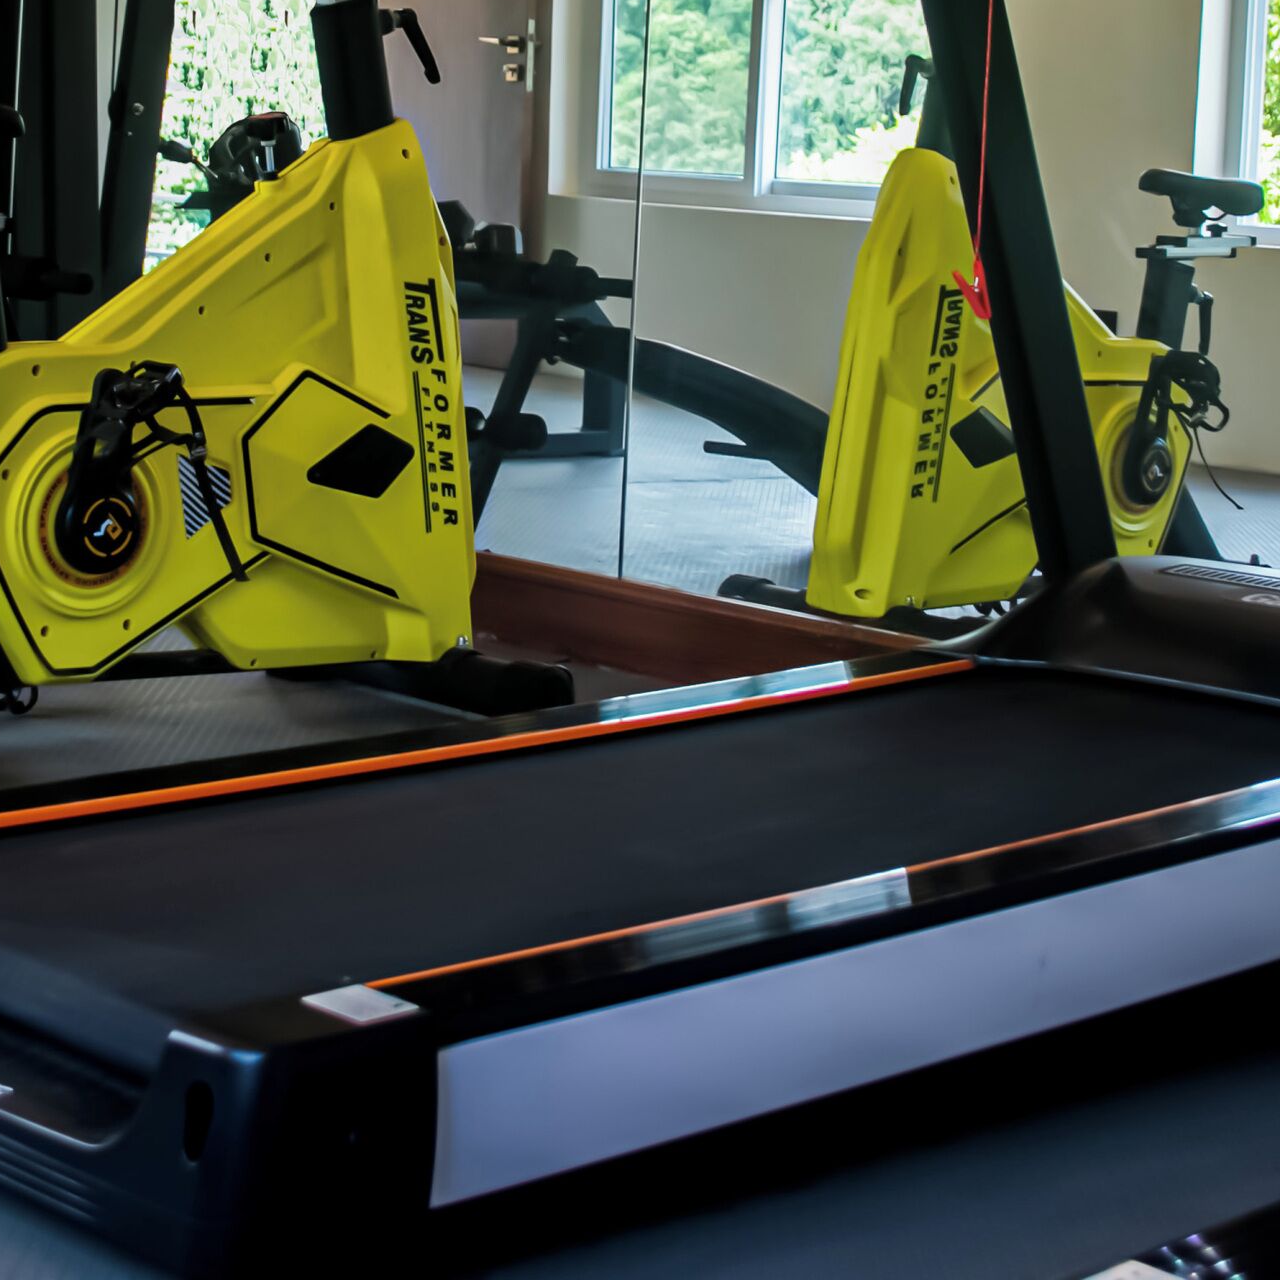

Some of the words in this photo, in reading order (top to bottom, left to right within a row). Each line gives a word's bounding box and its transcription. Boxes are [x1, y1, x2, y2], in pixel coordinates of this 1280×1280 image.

[403, 278, 444, 364] TRANS
[421, 386, 440, 513] FITNESS
[431, 368, 459, 526] FORMER
